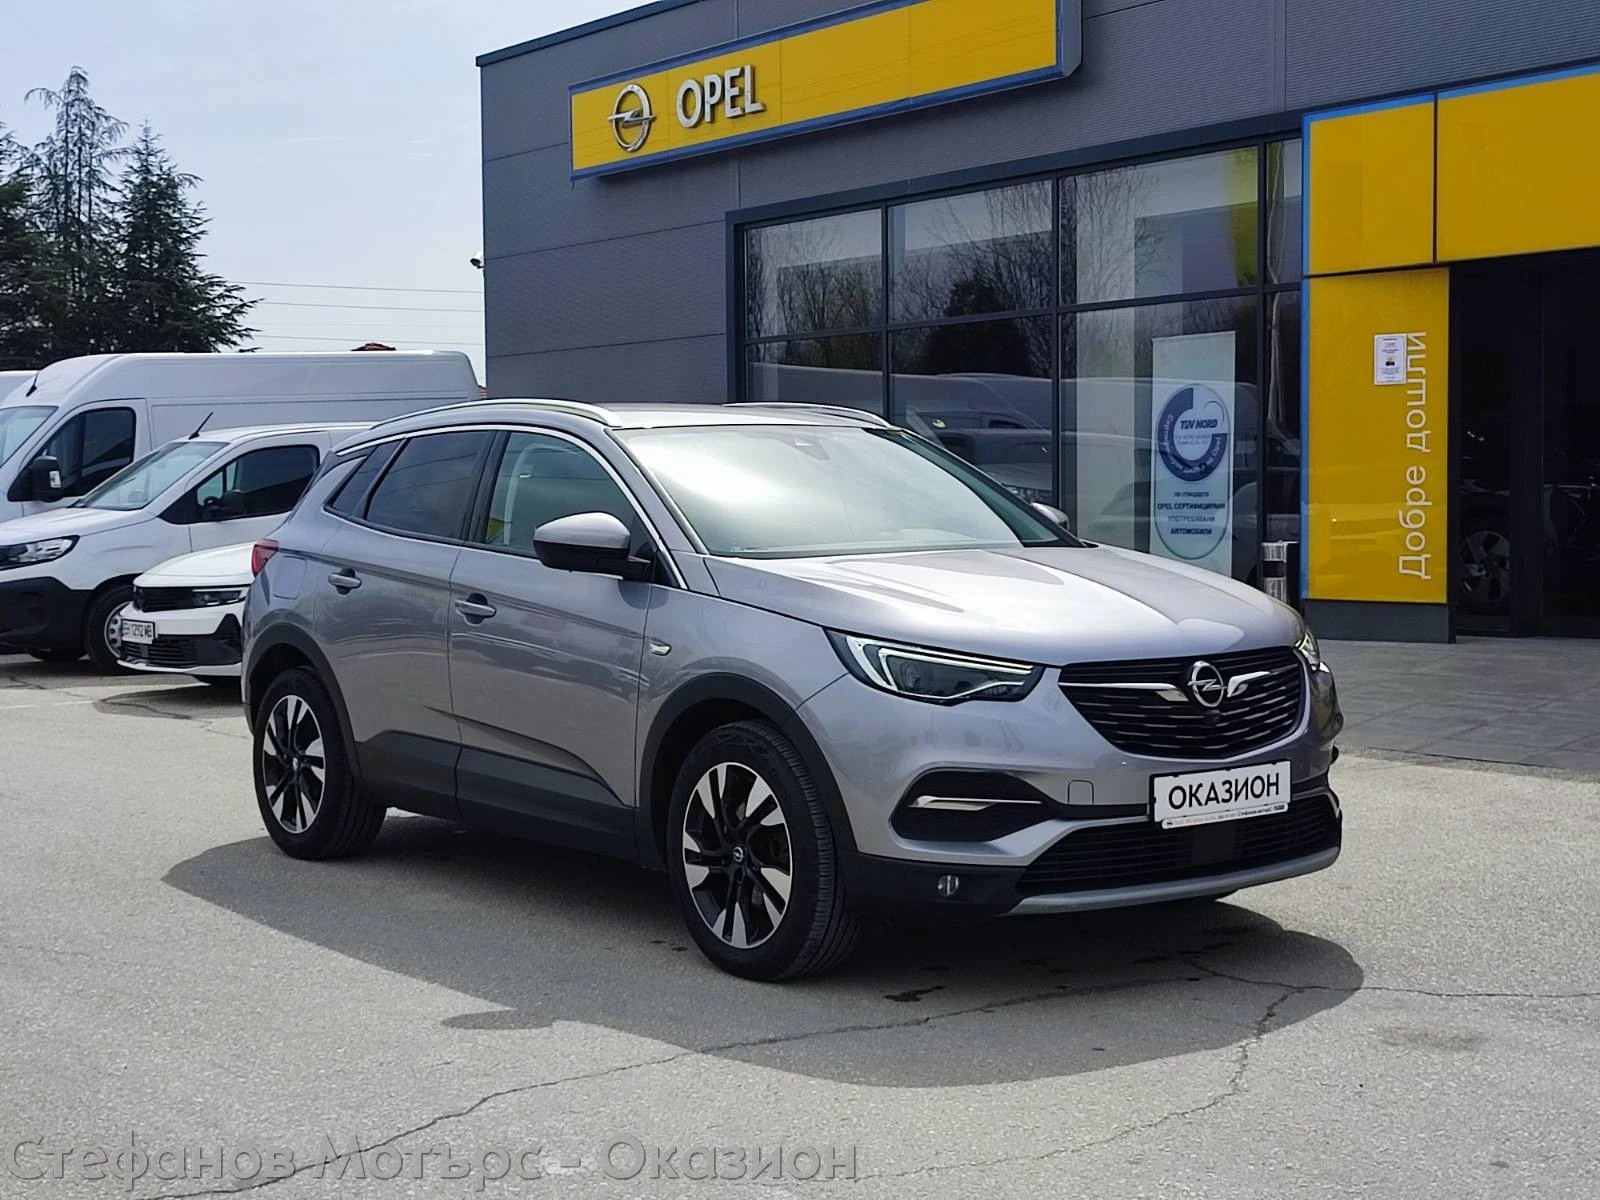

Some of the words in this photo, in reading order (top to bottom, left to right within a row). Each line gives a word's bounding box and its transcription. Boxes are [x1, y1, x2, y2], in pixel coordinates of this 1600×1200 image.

[676, 64, 765, 128] OPEL
[1195, 418, 1218, 429] NORD
[1406, 332, 1431, 453] дошли
[1399, 465, 1432, 580] Добре
[1168, 773, 1280, 810] ОКАЗИОН
